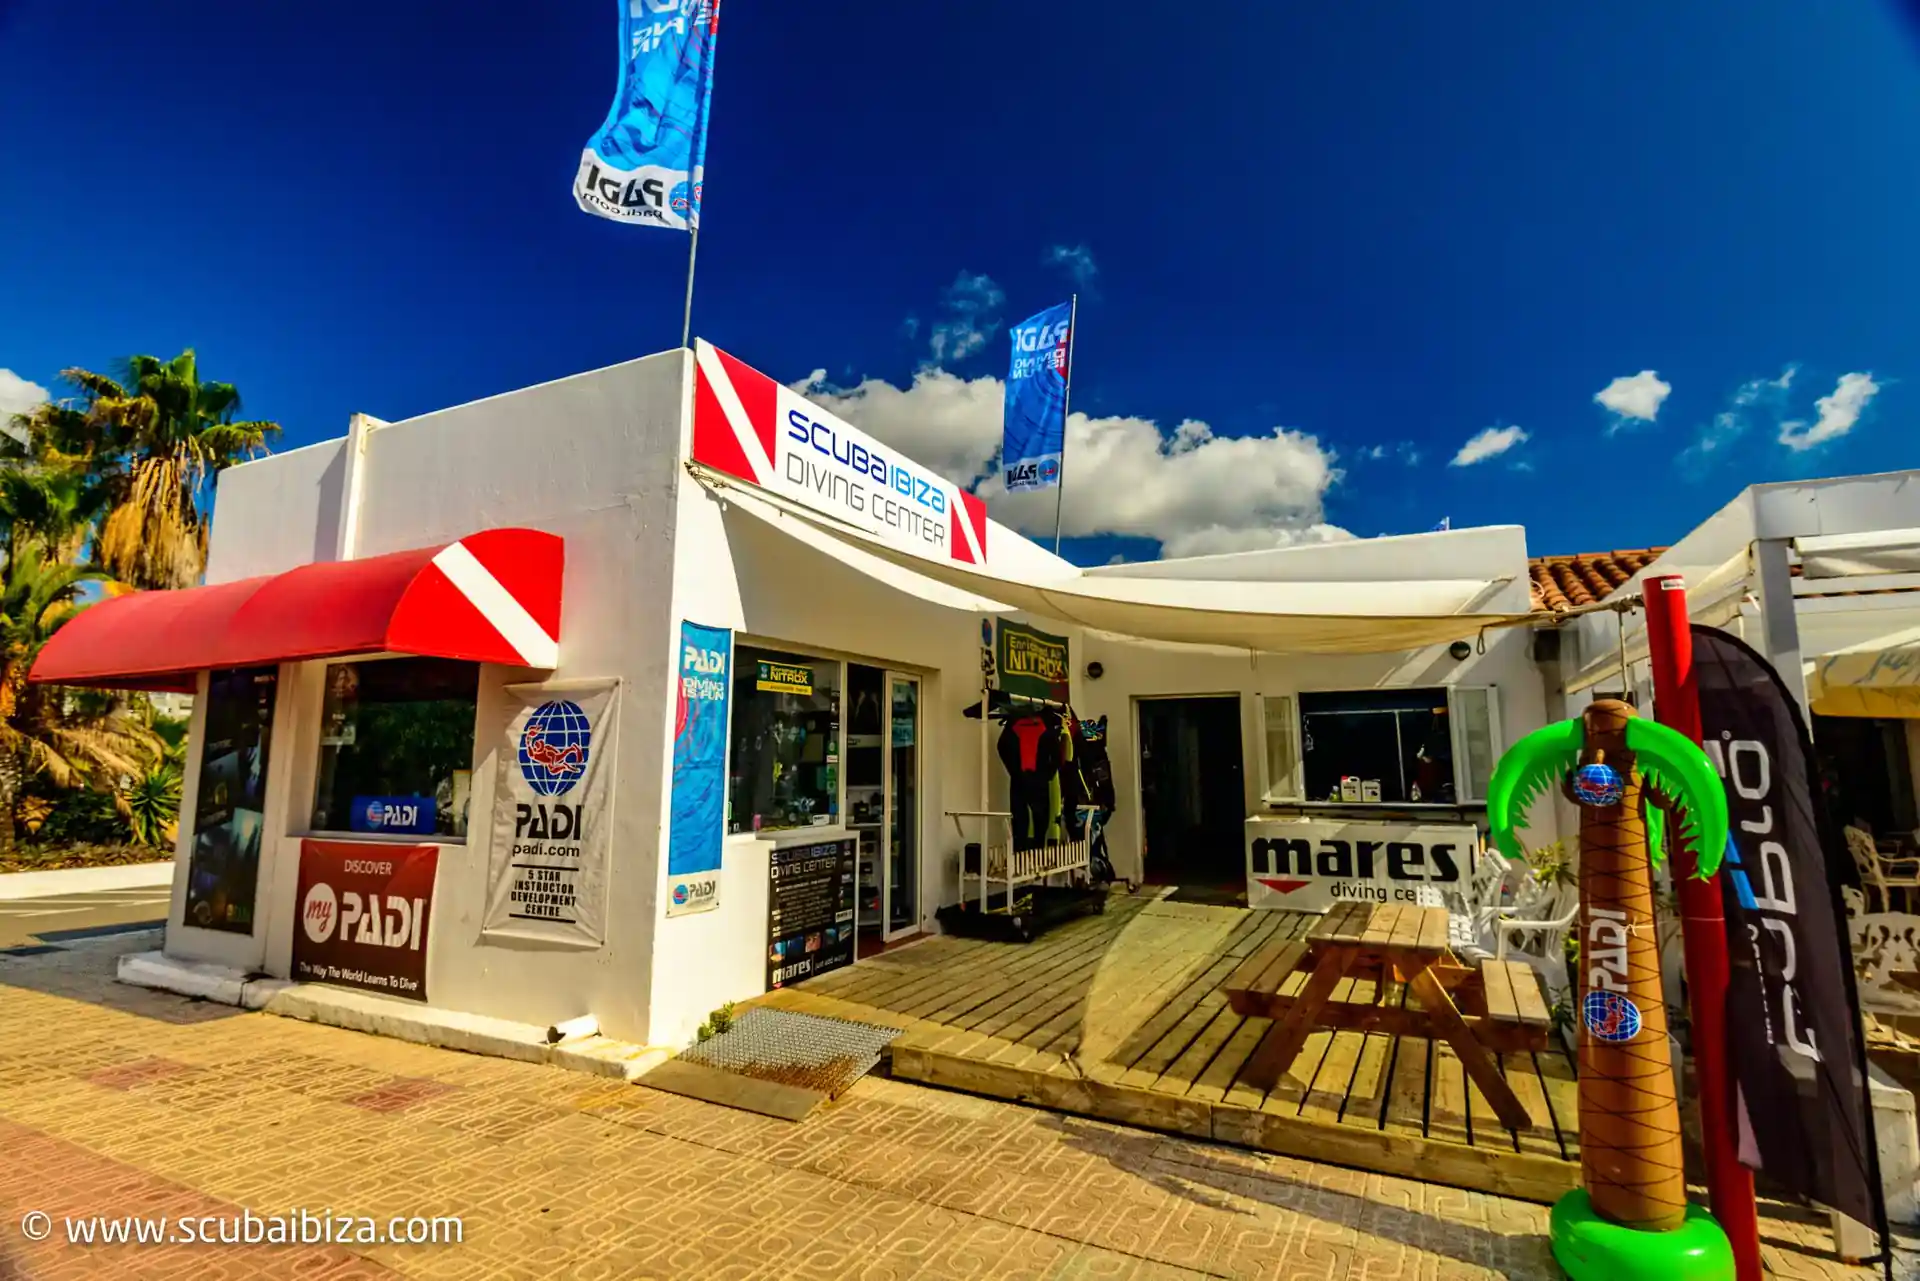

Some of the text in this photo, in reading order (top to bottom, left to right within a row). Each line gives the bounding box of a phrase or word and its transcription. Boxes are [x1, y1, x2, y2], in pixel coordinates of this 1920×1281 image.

[684, 646, 726, 674] PADI
[1010, 648, 1063, 678] NITROX
[683, 676, 724, 691] DIVING
[771, 671, 808, 685] NITROX
[384, 804, 417, 826] PADI
[515, 803, 582, 841] PADI
[512, 842, 580, 857] padi.com
[1251, 836, 1460, 883] mares
[344, 860, 392, 875] DISCOVER
[528, 869, 561, 882] 5 STAR
[514, 880, 574, 895] INSTRUCTOR
[689, 880, 716, 899] PADI
[1330, 882, 1388, 902] diving
[510, 891, 577, 907] DEVELOPMENT
[525, 904, 560, 917] CENTRE
[306, 891, 424, 951] my PADI
[1588, 908, 1628, 993] PADI
[312, 964, 328, 979] Way
[328, 965, 340, 978] The
[341, 968, 363, 981] World
[363, 972, 388, 986] Learns
[389, 975, 398, 988] To
[399, 977, 417, 991] Dive
[772, 959, 811, 984] mares
